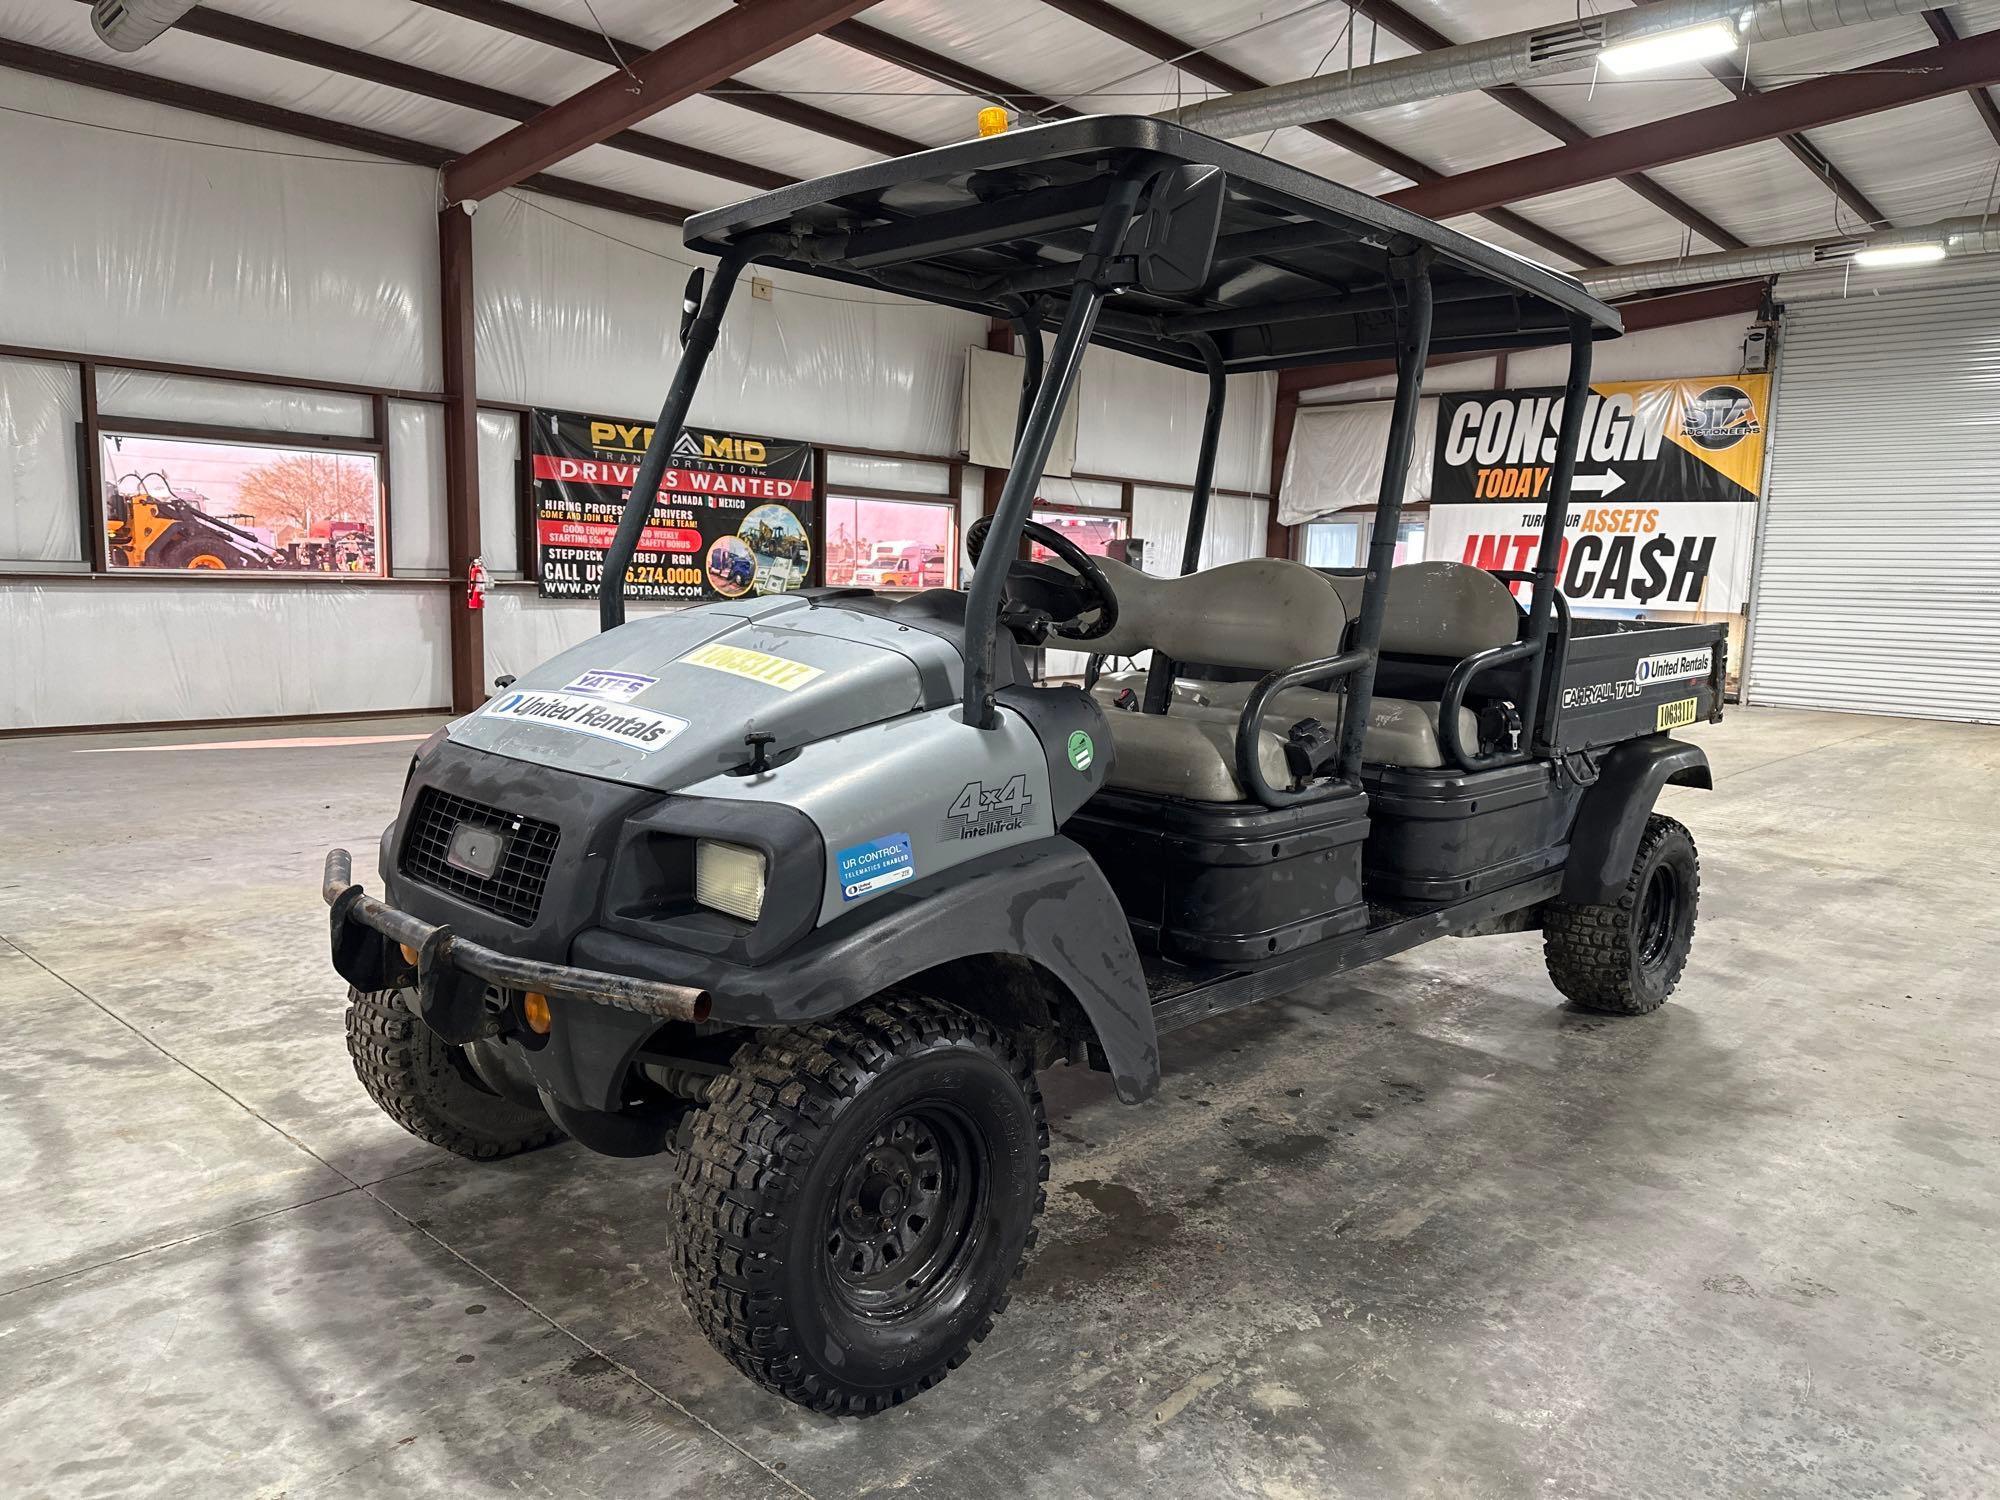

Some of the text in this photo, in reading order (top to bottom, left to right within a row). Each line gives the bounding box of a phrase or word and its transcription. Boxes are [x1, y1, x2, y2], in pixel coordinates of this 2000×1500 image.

[1682, 398, 1758, 429] STA
[1680, 427, 1760, 436] AUCTIONEERS
[593, 450, 759, 475] TRANORTATION
[560, 460, 793, 497] DRIVS WANTED
[1475, 468, 1549, 498] TODAY
[545, 499, 582, 512] HIRING
[654, 508, 693, 520] DRIVERS
[672, 494, 746, 509] CANADA MEXICO
[540, 510, 564, 519] COME
[566, 512, 581, 520] AND
[583, 513, 601, 522] JOIN
[603, 515, 616, 523] US.
[650, 518, 661, 526] OF
[662, 519, 675, 528] THE
[677, 519, 698, 528] TEAM!
[1580, 509, 1660, 533] ASSETS
[549, 532, 588, 544] STARTING
[640, 538, 665, 547] SAFETY
[666, 540, 691, 549] BONUS
[562, 524, 584, 534] GOOD
[653, 531, 680, 540] WEEKLY
[548, 548, 603, 562] STEPDECK
[632, 553, 658, 564] TBED
[671, 554, 693, 565] RGN
[1563, 532, 1717, 605] CA$H
[544, 562, 581, 581] CALL
[625, 566, 702, 585] 6.274.0000
[545, 582, 703, 597] WWW.PYIDTRANS.COM
[1651, 654, 1709, 678] United Rentals
[577, 675, 645, 694] YATES
[512, 696, 666, 742] United Rentals
[1660, 701, 1694, 727] 10633117
[947, 773, 1032, 823] 4x4
[960, 818, 1022, 839] IntelliTrak
[843, 844, 902, 870] UR CONTROL
[845, 854, 909, 880] TELEMATICS ENABLED
